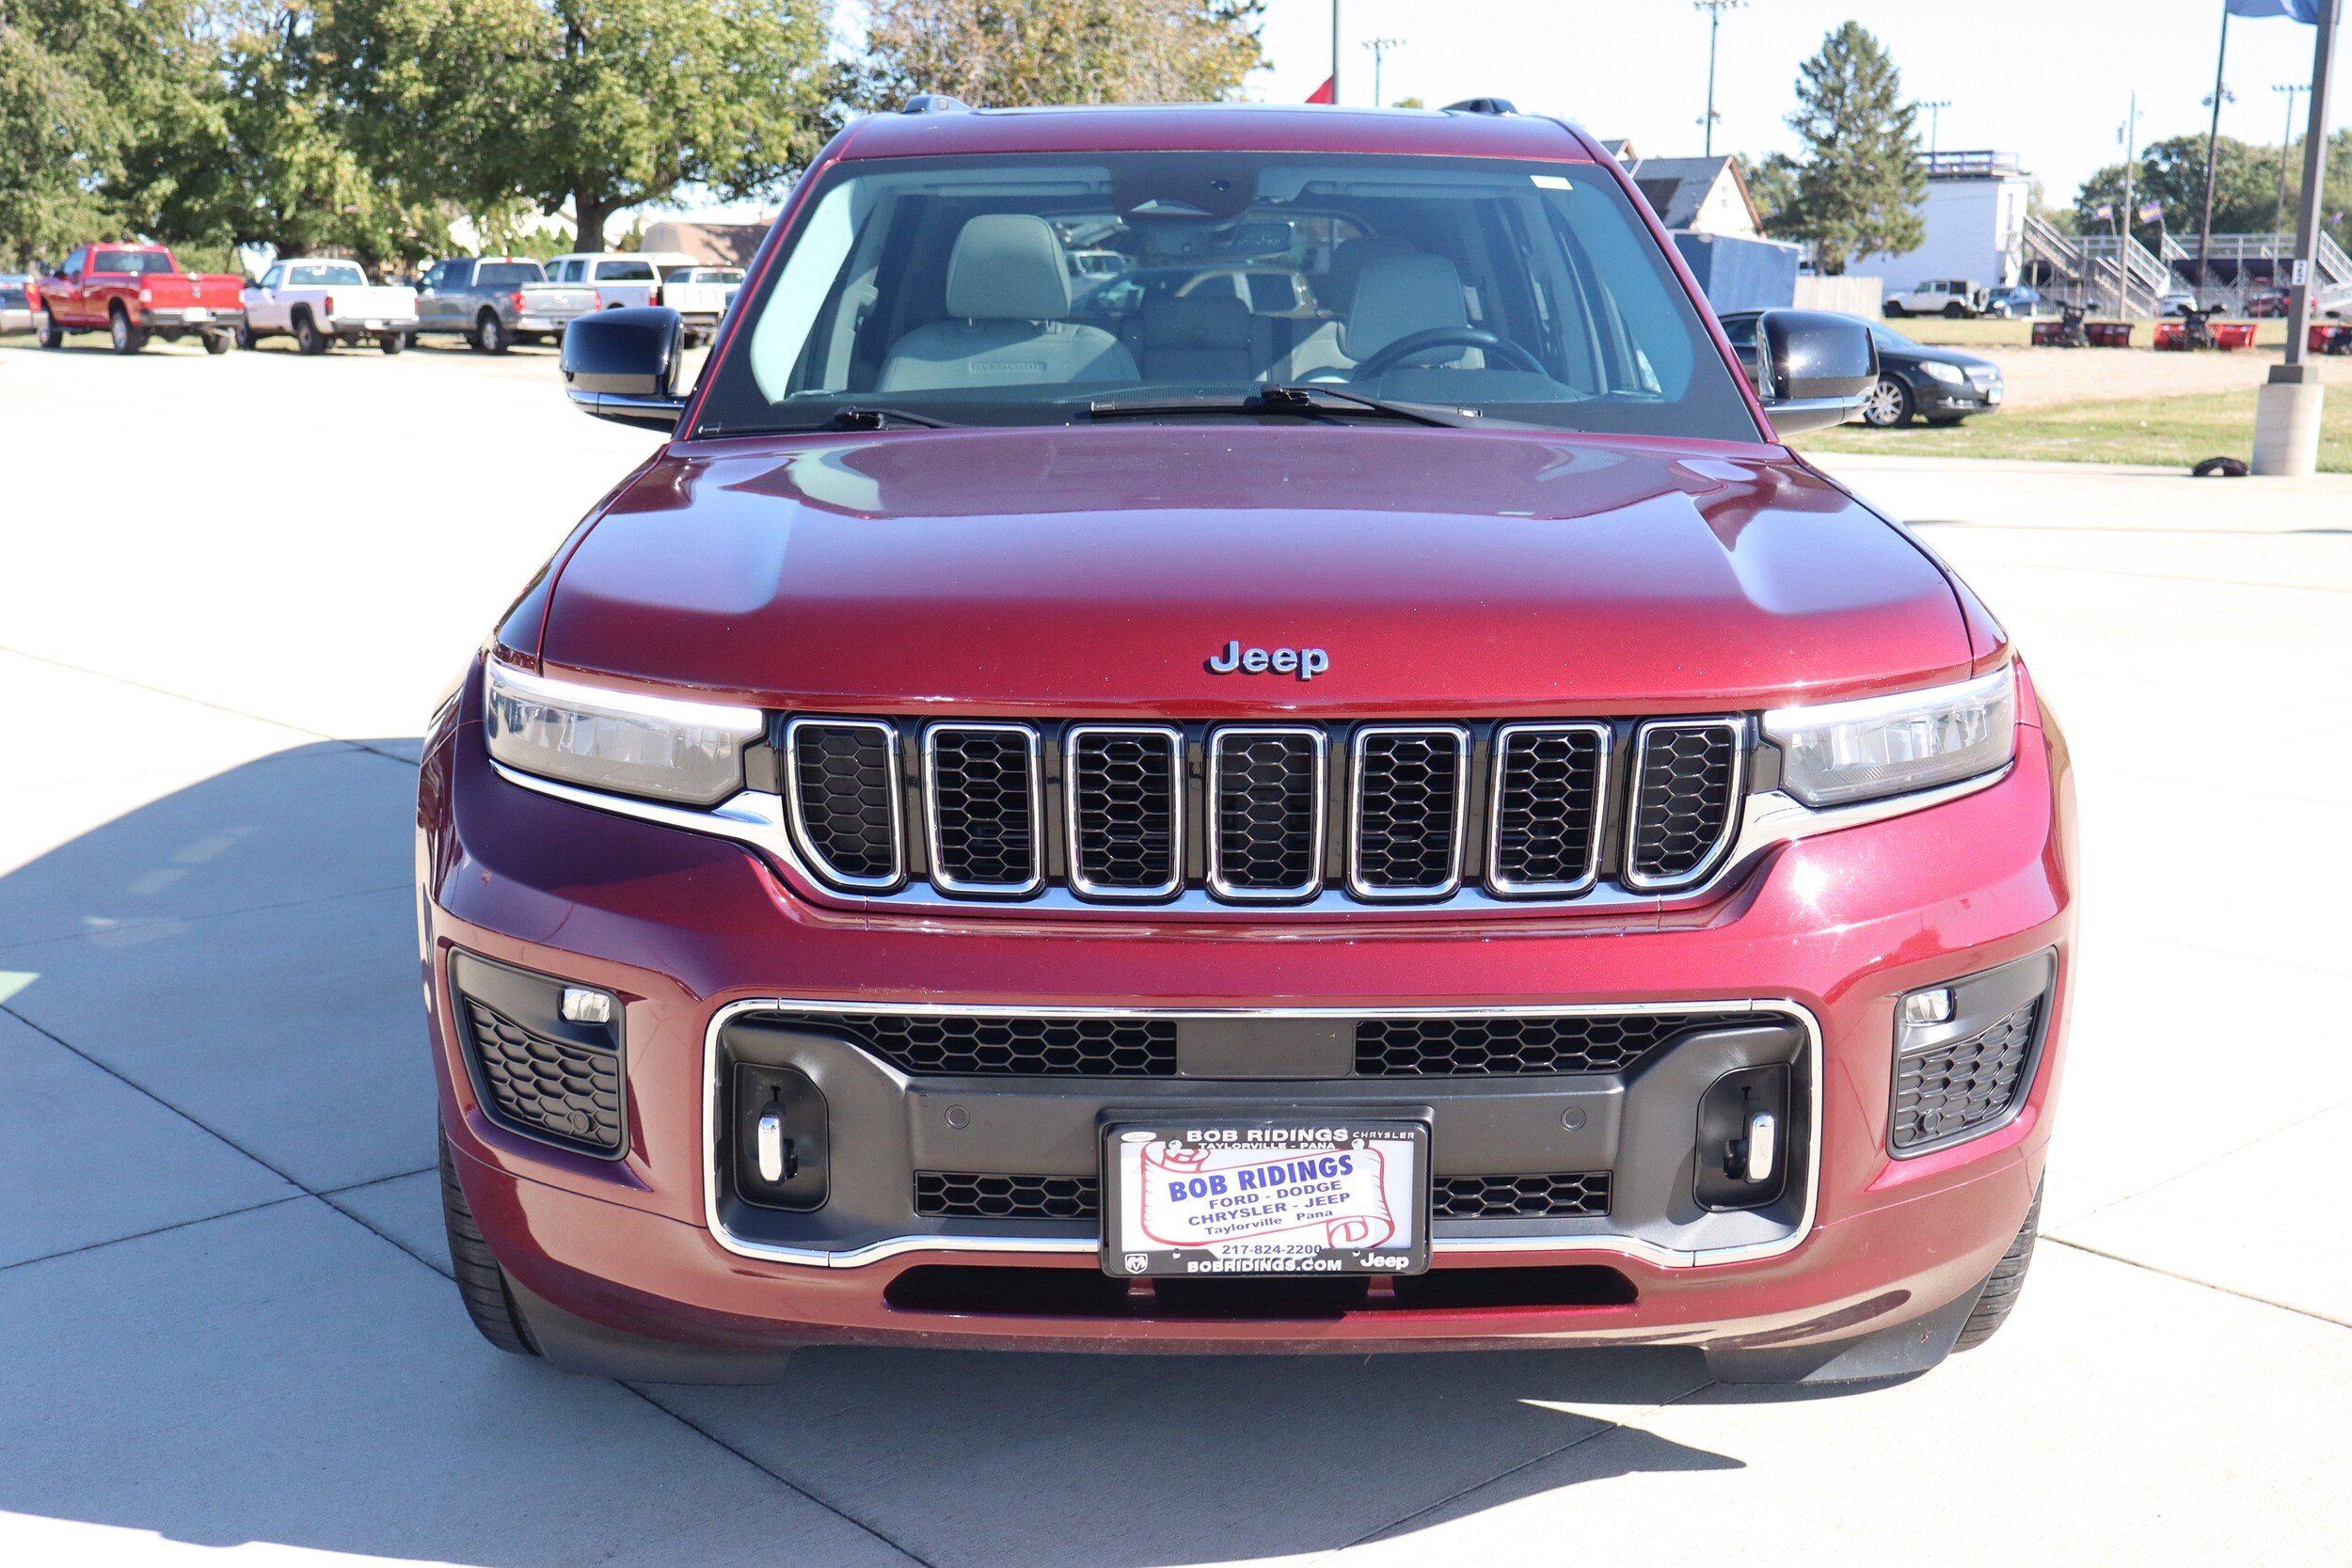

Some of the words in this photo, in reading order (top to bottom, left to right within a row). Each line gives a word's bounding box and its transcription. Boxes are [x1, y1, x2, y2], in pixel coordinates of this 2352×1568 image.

[1210, 641, 1328, 680] Jeep
[1186, 1130, 1238, 1142] BOB
[1248, 1129, 1348, 1142] RIDINGS
[1168, 1175, 1228, 1202] BOB
[1237, 1154, 1354, 1191] RIDINGS
[1209, 1194, 1260, 1210] FORD
[1277, 1180, 1343, 1198] DODGE
[1188, 1202, 1287, 1227] CHRYSLER
[1304, 1193, 1351, 1209] JEEP
[1204, 1217, 1282, 1235] Taylorville
[1296, 1210, 1333, 1221] Pana
[1222, 1244, 1323, 1255] 217-824-2200
[1360, 1253, 1409, 1270] Jeep
[1187, 1259, 1343, 1272] BOBRIDINGS.COM
